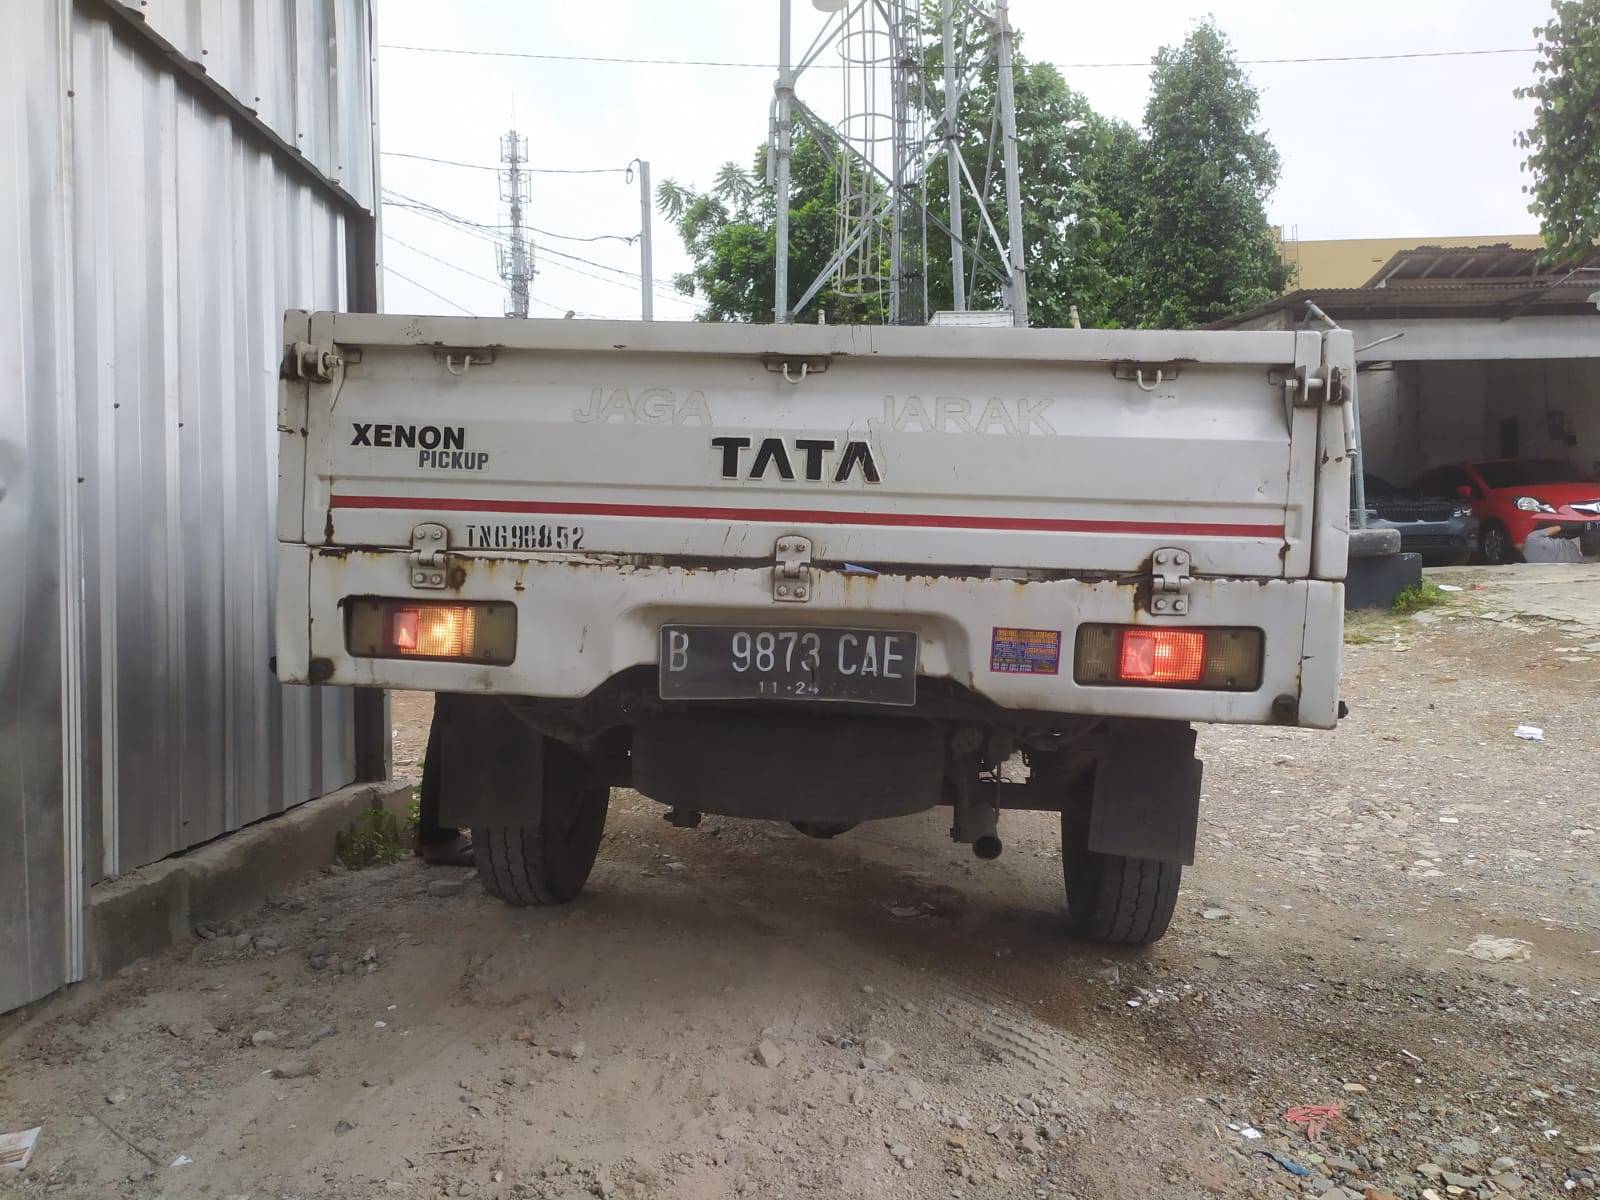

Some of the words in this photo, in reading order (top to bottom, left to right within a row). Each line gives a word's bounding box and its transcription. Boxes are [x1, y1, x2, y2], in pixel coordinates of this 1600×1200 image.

[573, 386, 713, 425] JAGA
[867, 394, 1057, 436] JARAK
[350, 422, 466, 450] XENON
[418, 450, 489, 470] PICKUP
[711, 437, 882, 483] TATA
[668, 630, 690, 672] B
[732, 631, 821, 672] 9873
[838, 633, 904, 679] CAE
